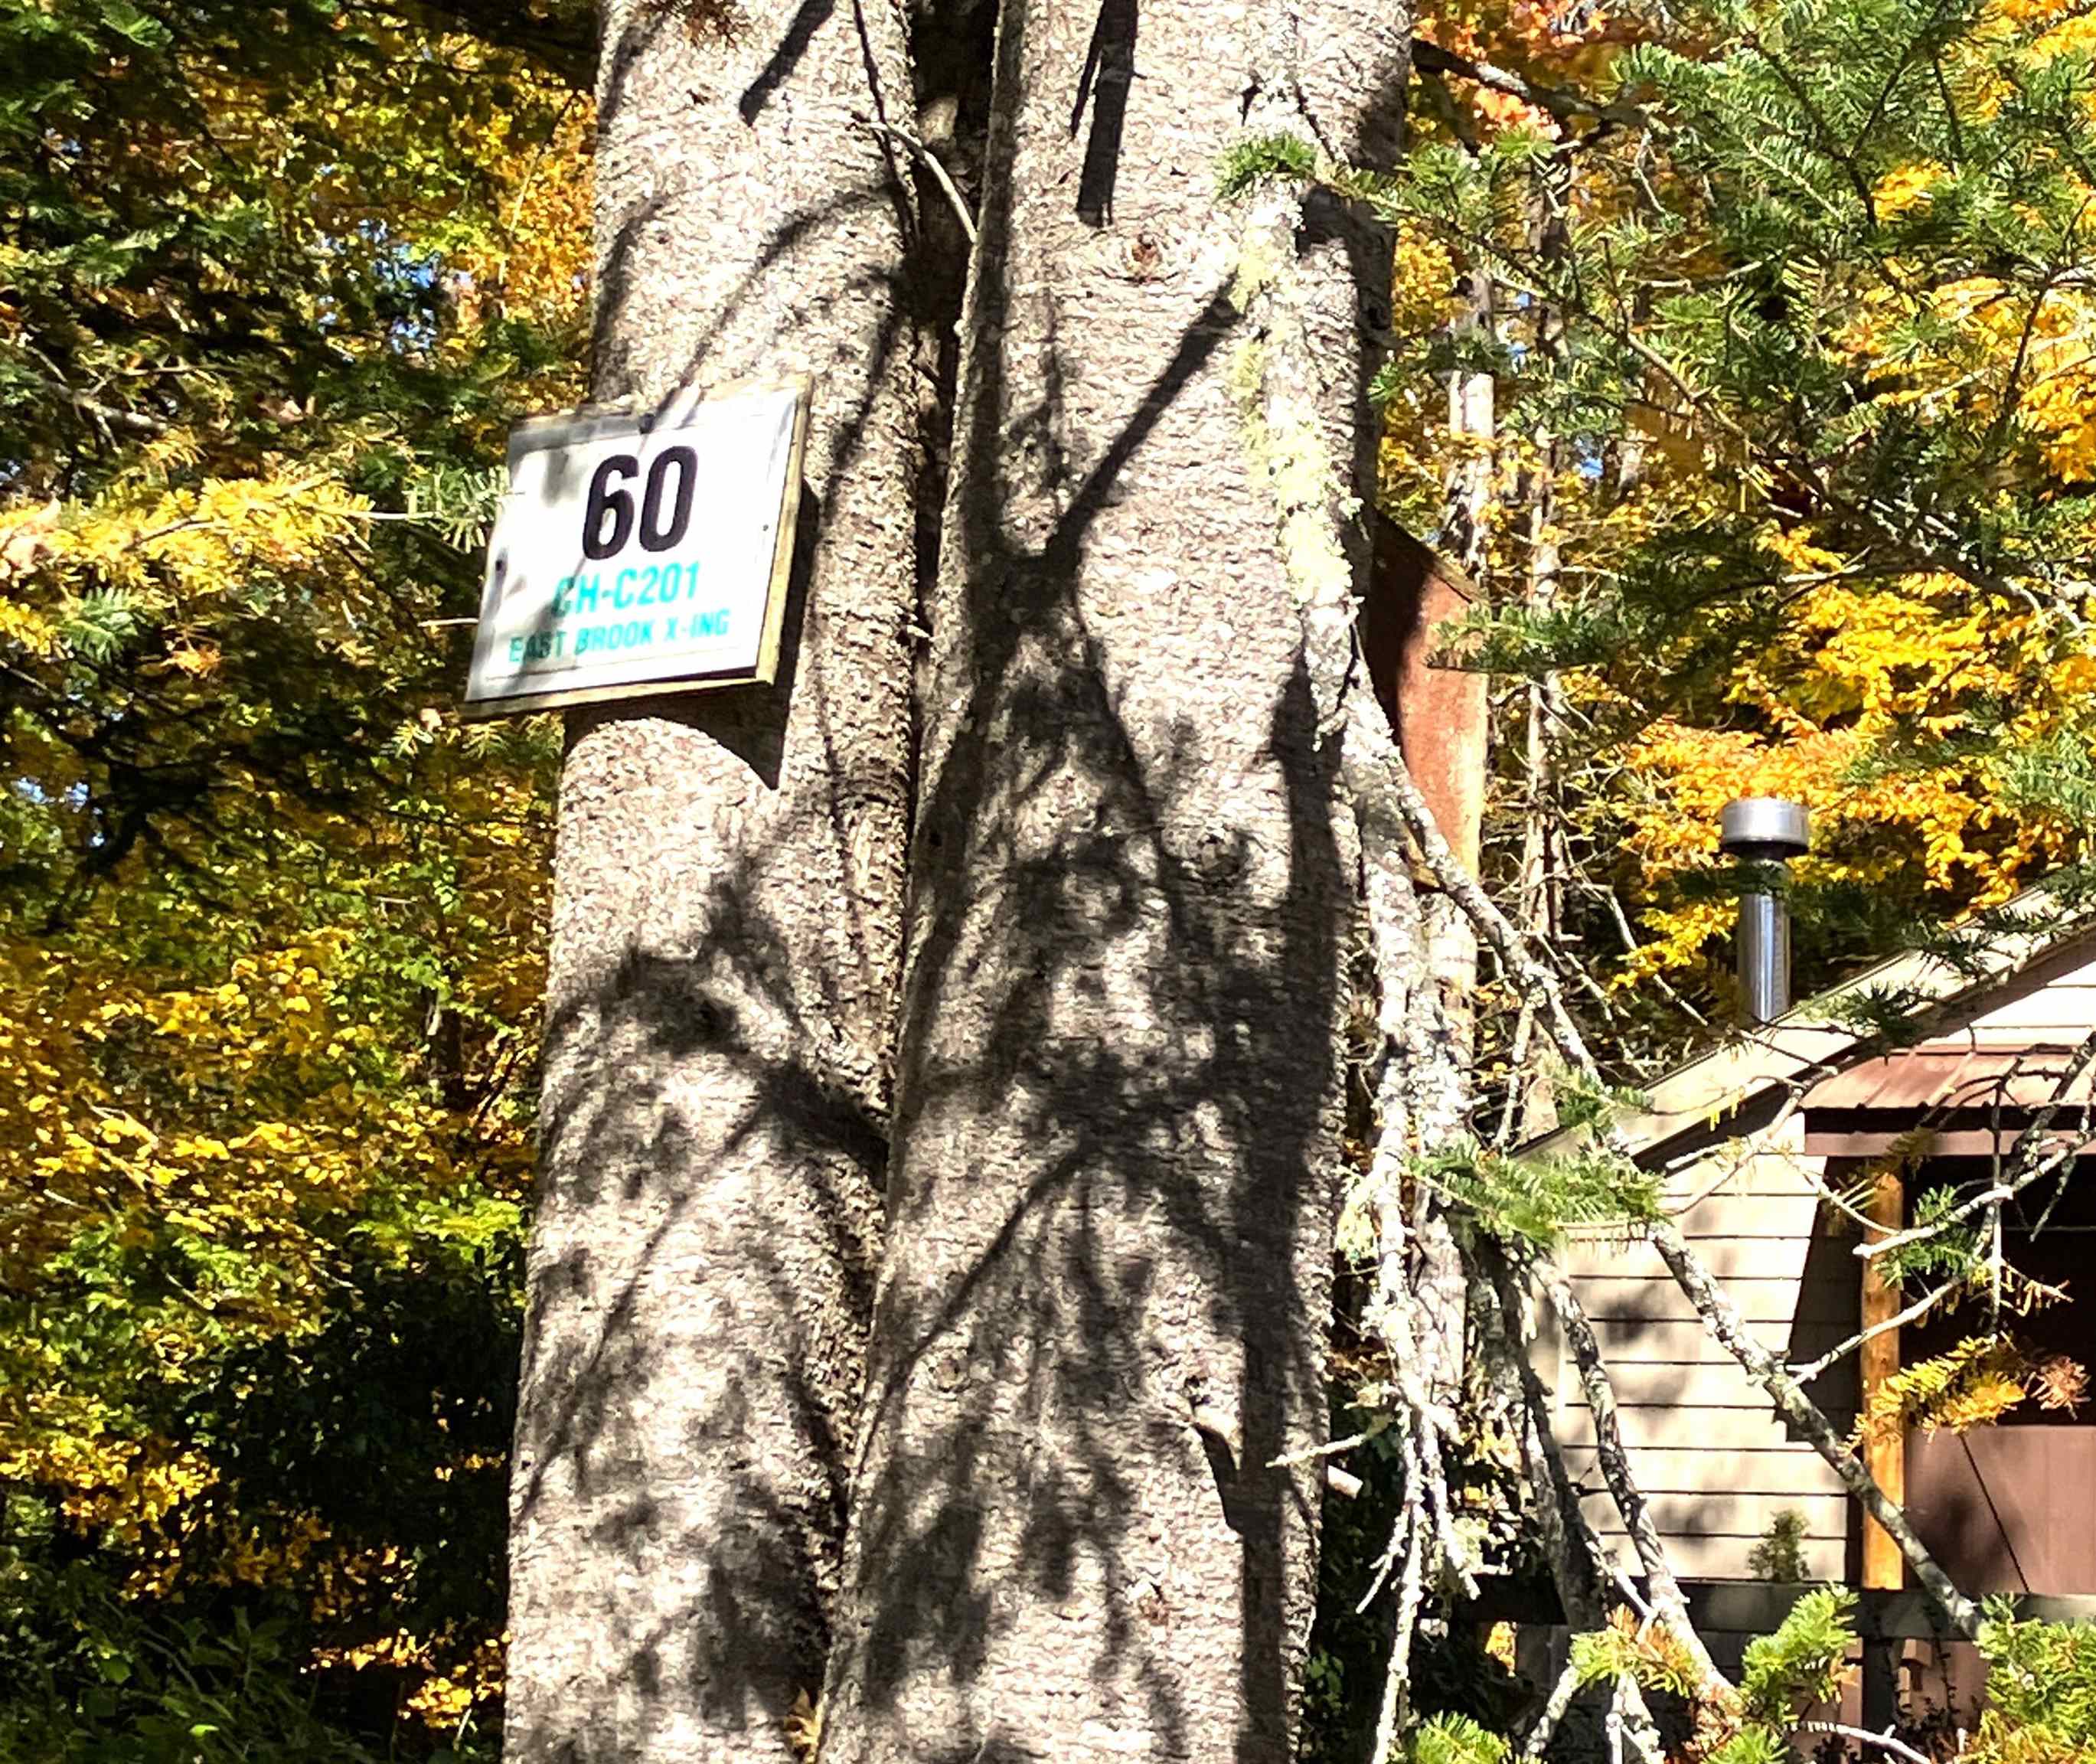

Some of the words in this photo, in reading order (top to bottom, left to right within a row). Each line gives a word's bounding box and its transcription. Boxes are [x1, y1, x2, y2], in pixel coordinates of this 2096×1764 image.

[583, 446, 698, 560] 60
[509, 632, 566, 662] EAST
[575, 622, 653, 655] BROOK
[665, 609, 730, 639] X-ING
